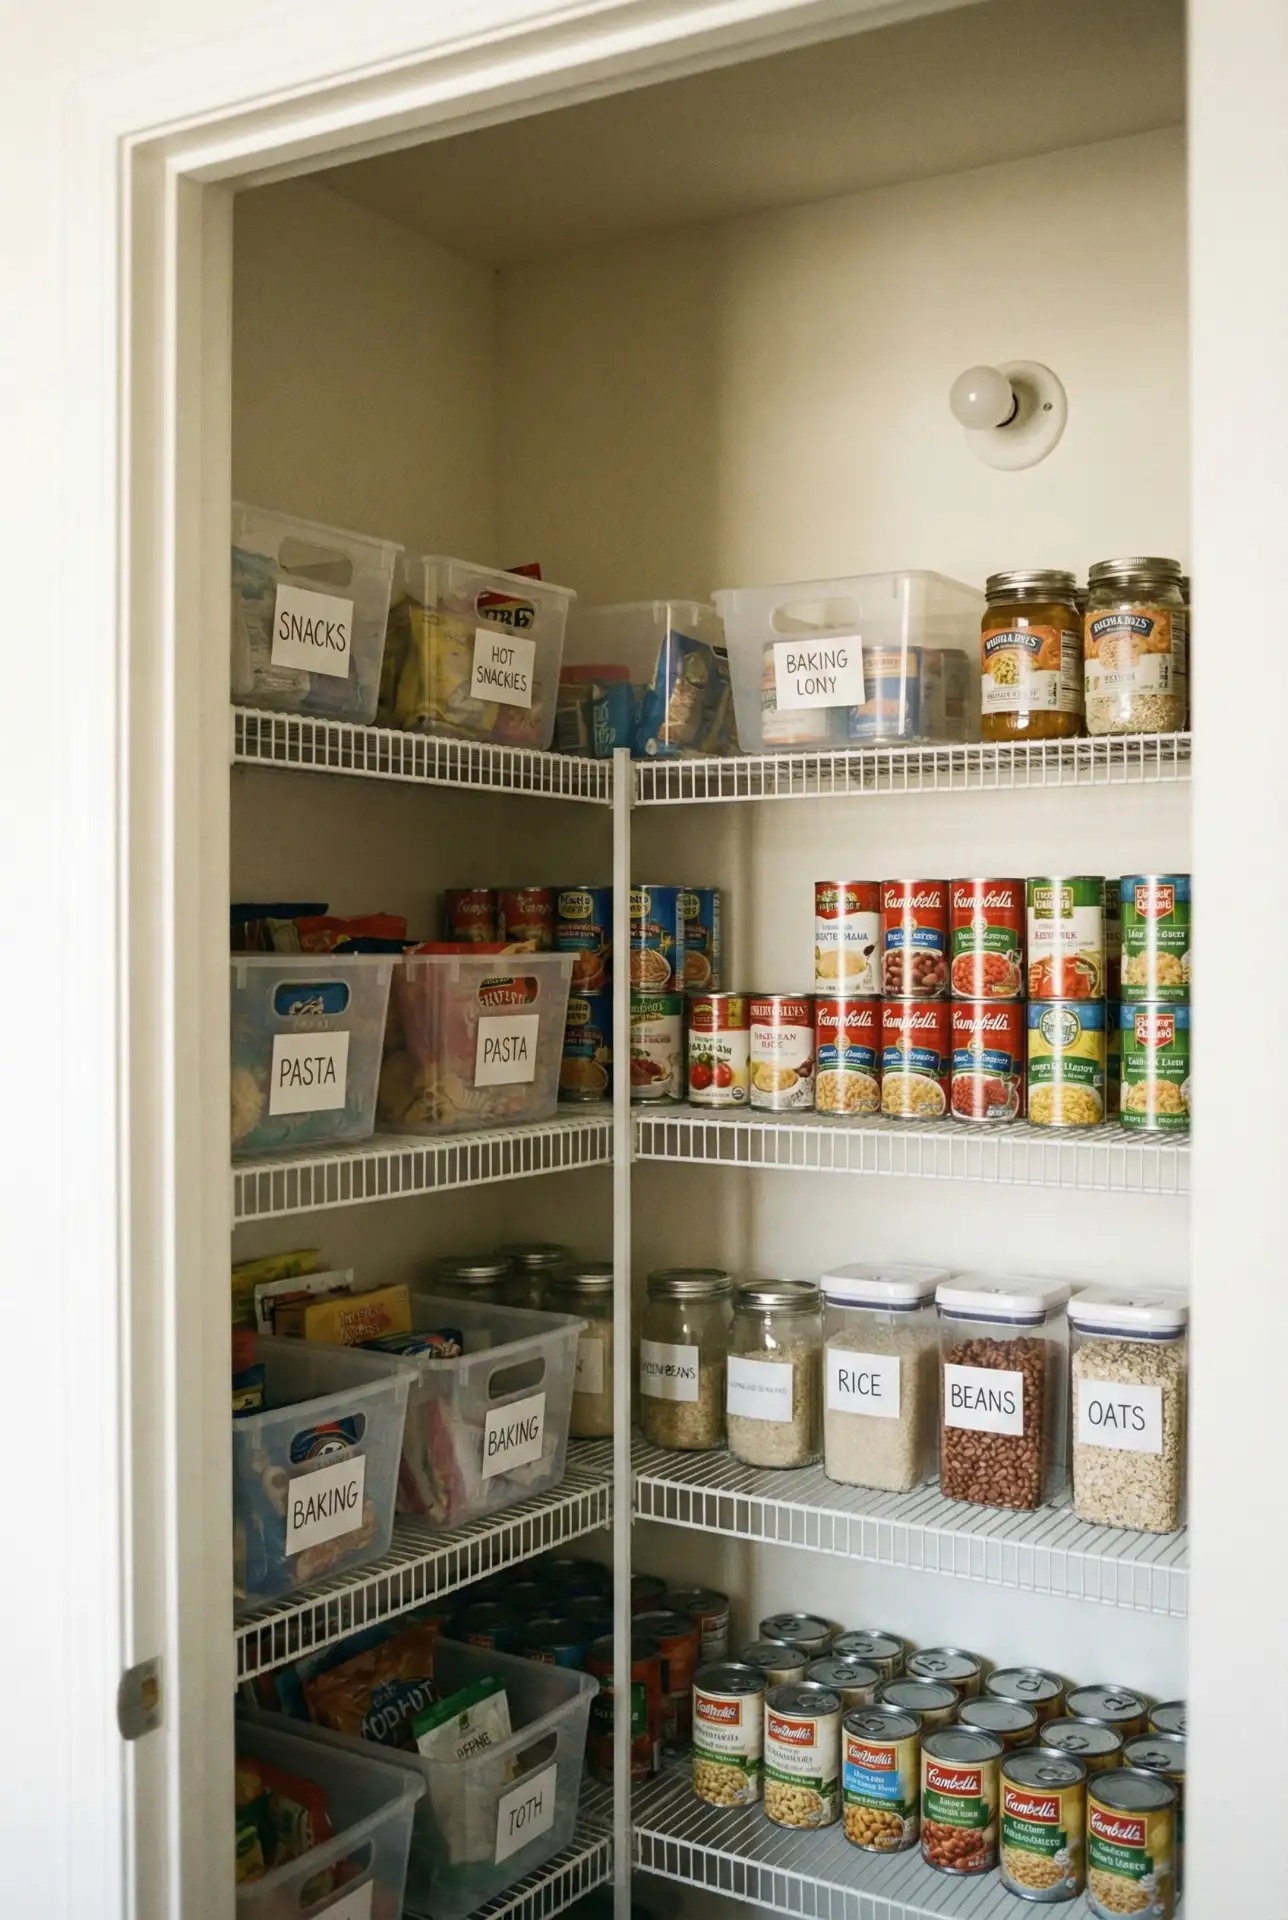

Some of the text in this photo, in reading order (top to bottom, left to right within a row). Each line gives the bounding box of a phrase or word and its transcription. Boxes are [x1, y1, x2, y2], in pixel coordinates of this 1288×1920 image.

[279, 611, 346, 652] SNACKS
[491, 645, 515, 666] HOT
[786, 649, 848, 673] BAKING
[476, 665, 527, 692] SNACKIES
[796, 676, 837, 695] LONY
[483, 1036, 528, 1063] PASTA
[279, 1056, 336, 1088] PASTA
[838, 1369, 882, 1397] RICE
[951, 1384, 1016, 1415] BEANS
[1088, 1400, 1146, 1431] OATS
[487, 1415, 540, 1457] BAKING
[293, 1480, 358, 1530] BAKING
[508, 1791, 543, 1836] TOTH
